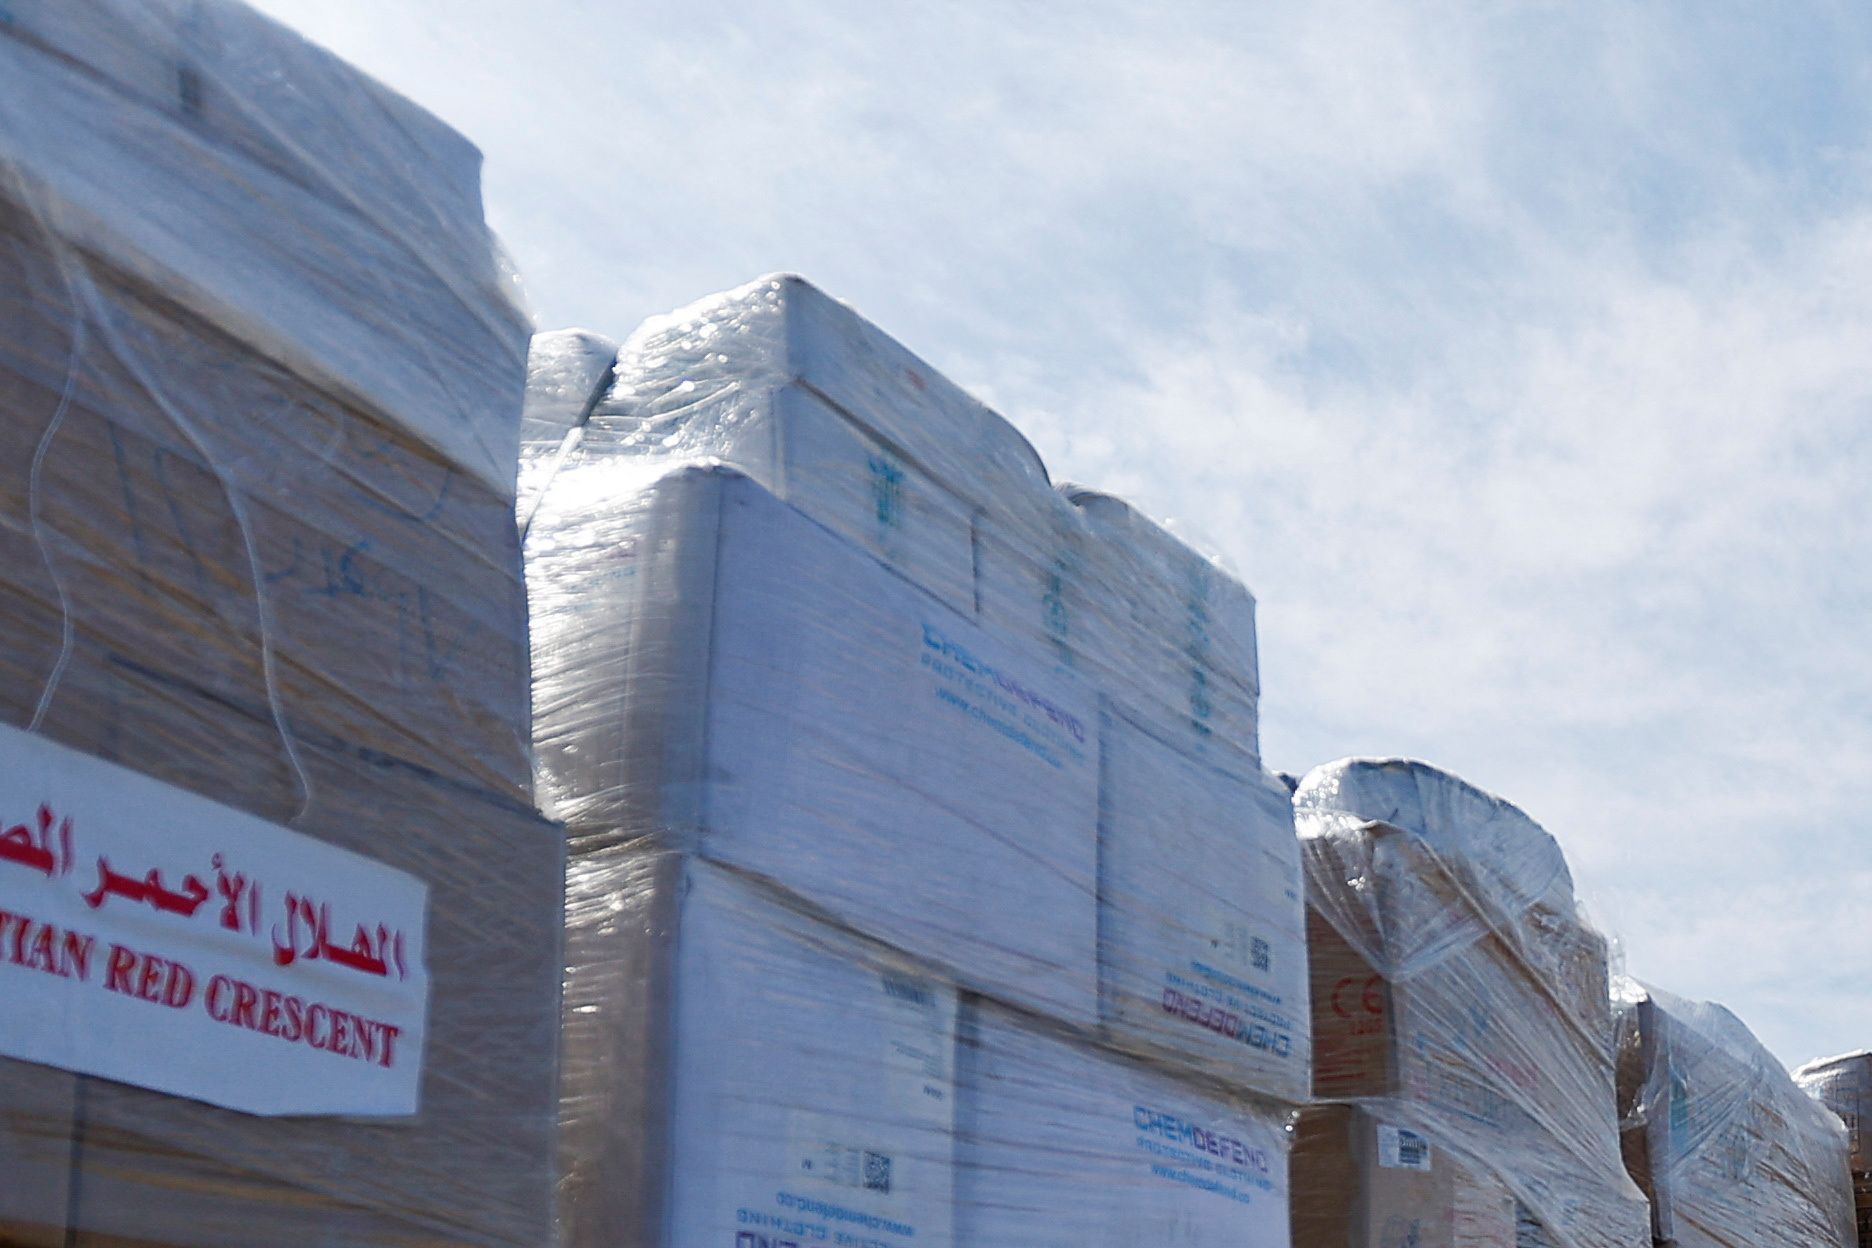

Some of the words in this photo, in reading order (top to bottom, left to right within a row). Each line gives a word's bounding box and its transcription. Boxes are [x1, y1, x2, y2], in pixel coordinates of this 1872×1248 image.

[79, 852, 260, 937] الأحمر
[272, 891, 406, 982] الهلال
[103, 942, 195, 1009] RED
[204, 972, 402, 1068] CRESCENT
[1133, 1104, 1268, 1173] CHEMDEFEND
